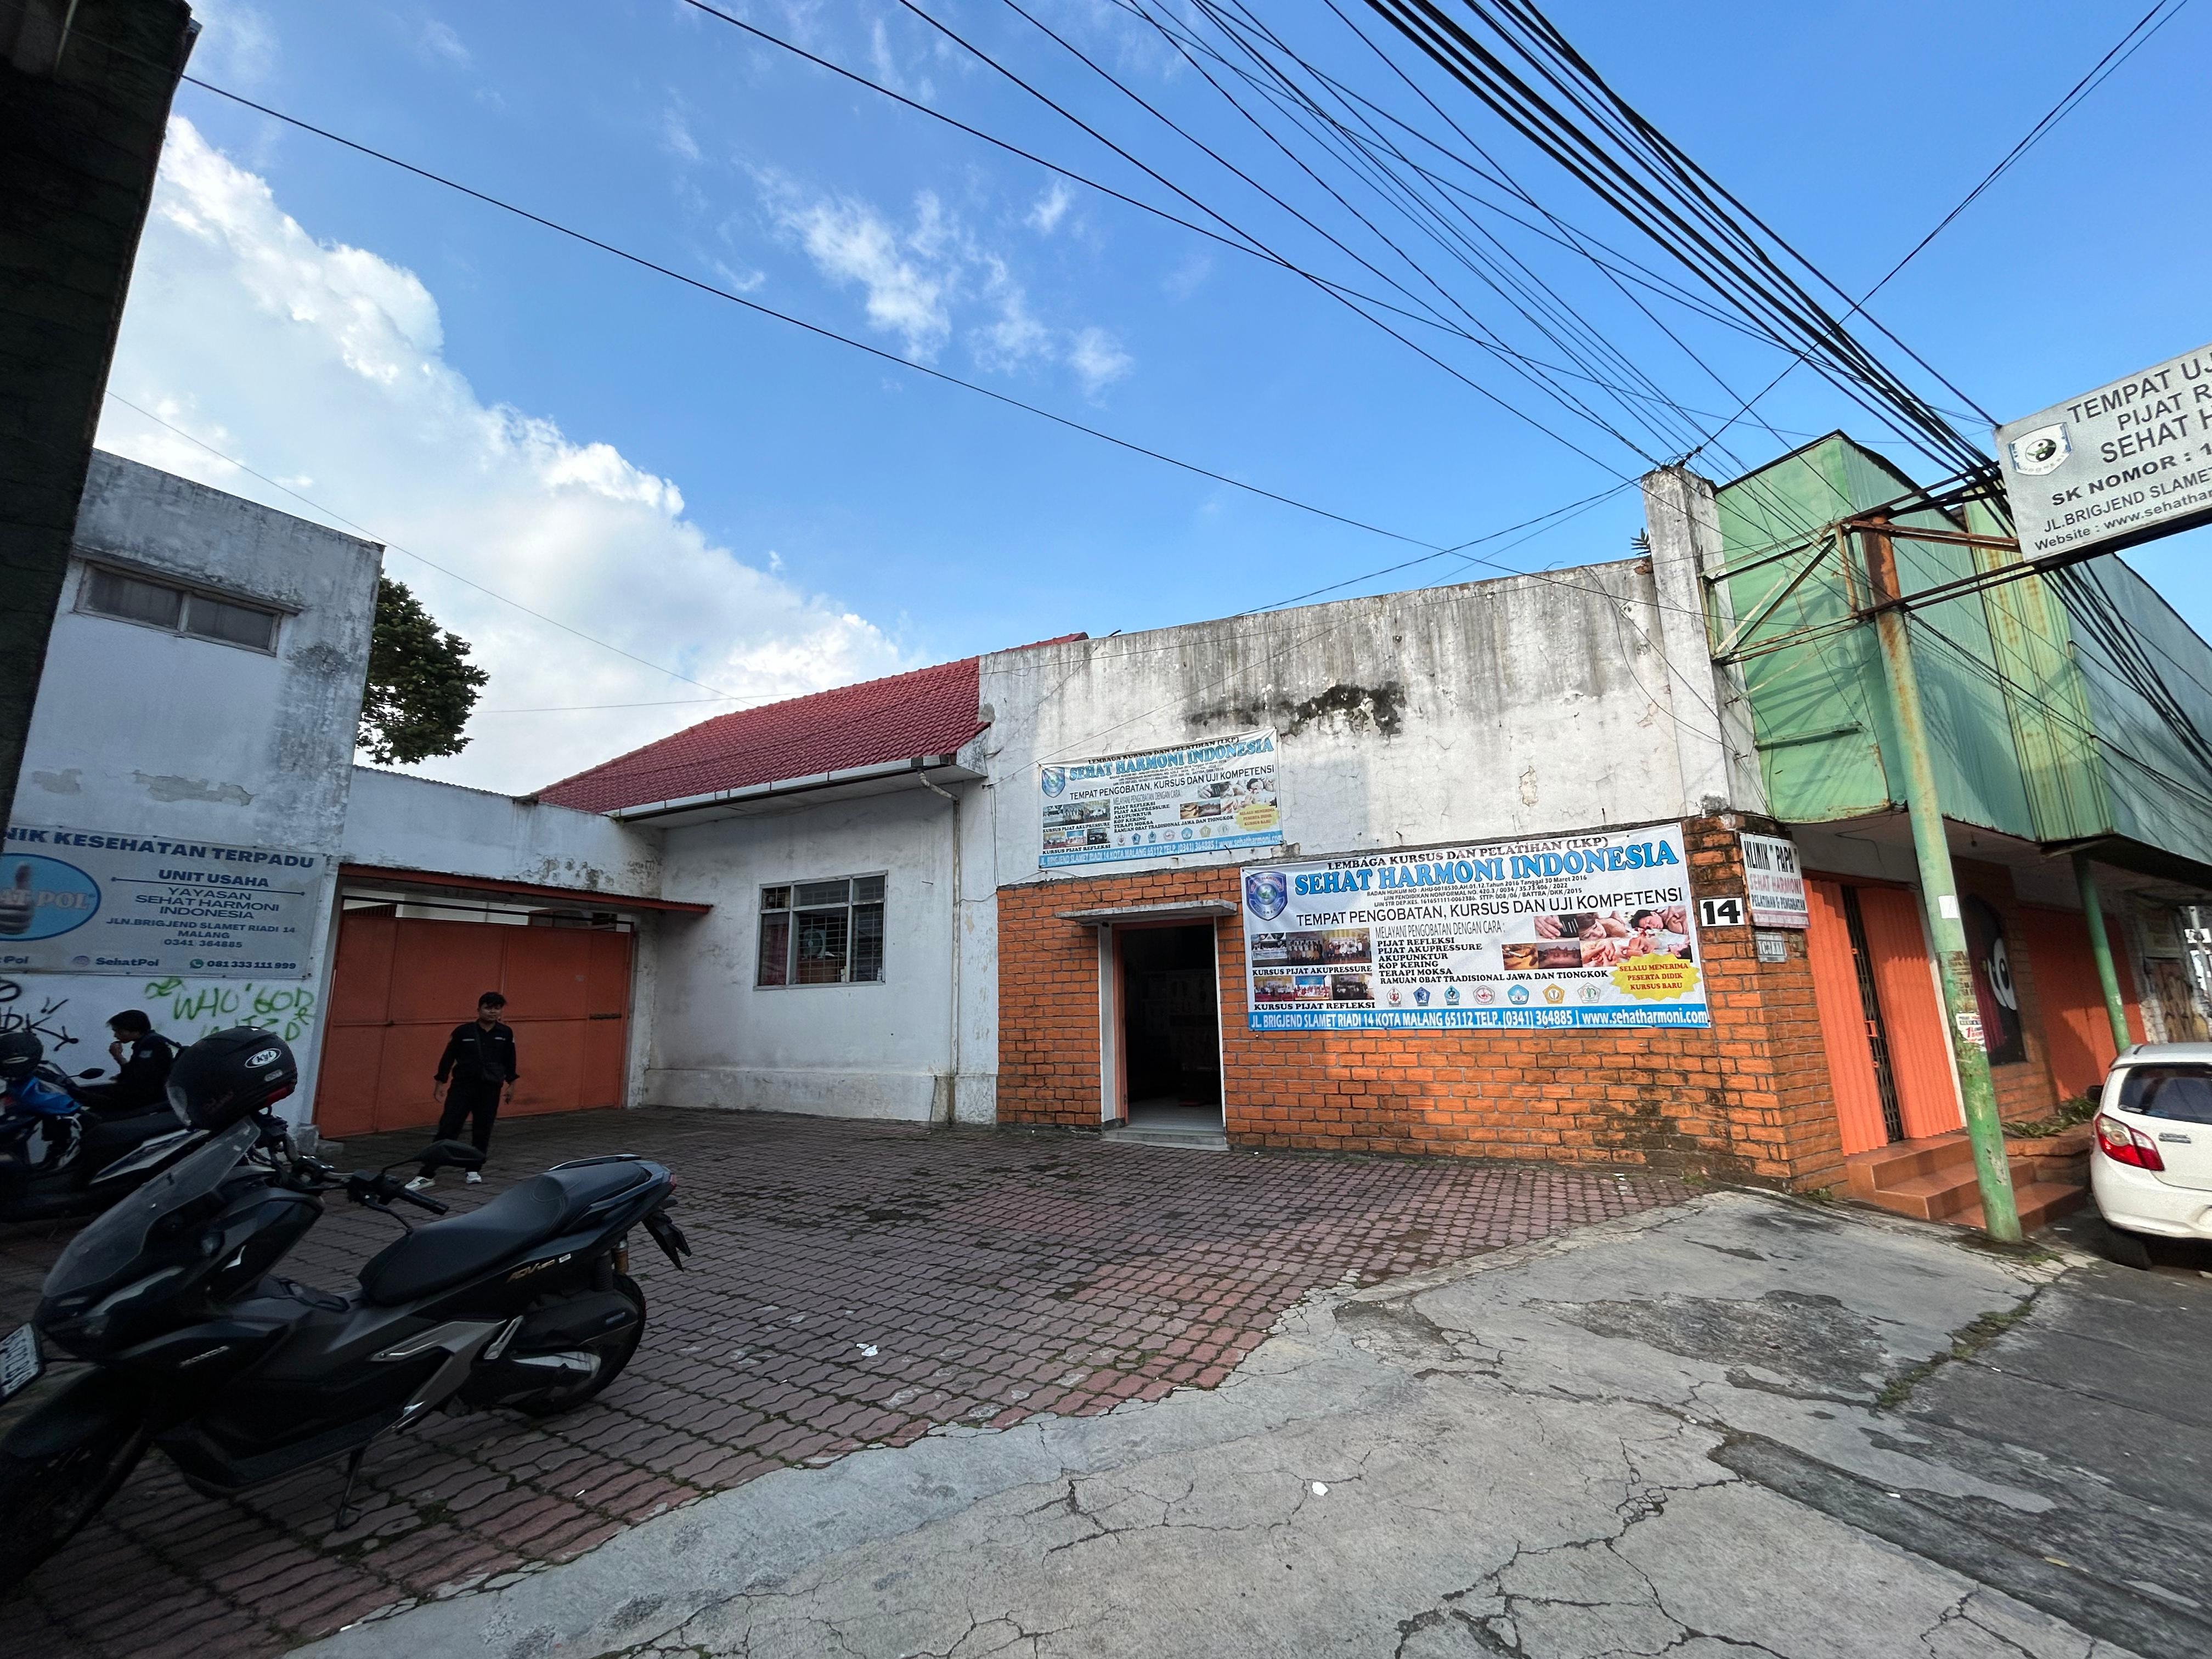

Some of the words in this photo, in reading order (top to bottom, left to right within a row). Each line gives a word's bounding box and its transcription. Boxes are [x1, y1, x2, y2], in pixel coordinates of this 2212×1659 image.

[2067, 369, 2170, 423] TEMPAT
[2117, 392, 2182, 431] PIJAT
[2100, 414, 2188, 462] SEHAT
[2052, 487, 2083, 506] SK
[2089, 455, 2177, 494] NOMOR
[2044, 491, 2146, 533] JL.BRIGJEND
[2151, 467, 2212, 498] SLAME
[2034, 527, 2091, 550] Website
[1070, 763, 1113, 781] SEHAT
[1116, 752, 1185, 775] HARMONI
[1187, 737, 1274, 764] INDONESIA
[1070, 789, 1097, 800] TEMPAT
[1154, 777, 1185, 789] KURSUS
[1187, 775, 1204, 785] DAN
[1206, 772, 1218, 782] UJI
[1221, 764, 1274, 779] KOMPETENSI
[54, 831, 206, 857] KESEHATAN
[212, 848, 314, 868] TERPADU
[1328, 857, 1387, 871] LEMBAGA
[1390, 851, 1443, 865] KURSUS
[1447, 850, 1476, 860] DAN
[1480, 841, 1562, 857] PELATIHAN
[1566, 837, 1609, 850] (LKP)
[1744, 840, 1770, 871] KLINIK
[1295, 868, 1373, 895] SEHAT
[1377, 857, 1505, 889] HARMONI
[1509, 840, 1679, 879] INDONESIA
[159, 870, 205, 882] UNIT
[207, 873, 269, 887] USAHA
[1749, 873, 1769, 891] SEHAT
[1772, 877, 1802, 894] HARMONI
[37, 890, 90, 910] POL
[135, 895, 196, 906] SEHAT
[199, 899, 279, 911] HARMONI
[168, 887, 251, 900] YAYASAN
[160, 906, 255, 919] INDONESIA
[1297, 911, 1346, 926] TEMPAT
[1350, 906, 1447, 923] PENGOBATAN,
[1451, 901, 1509, 917] KURSUS
[1514, 899, 1545, 913] DAN
[1549, 896, 1571, 911] UJI
[1577, 887, 1683, 909] KOMPETENSI
[1703, 900, 1740, 925] 14
[178, 930, 230, 939] MALANG
[200, 922, 245, 931] SLAMET
[1375, 925, 1407, 939] MELAYANI
[1408, 923, 1452, 938] PENGOBATAN
[1453, 921, 1482, 935] DENGAN
[1483, 920, 1502, 933] CARA
[1407, 937, 1455, 945] REFLEKSI
[1408, 943, 1482, 953] AKUPRESSURE
[96, 957, 159, 966] SehatPol
[1379, 953, 1448, 962] AKUPUNKTUR
[1400, 960, 1438, 968] KERING
[1619, 964, 1647, 972] SELALU
[1649, 962, 1689, 971] MENERIMA
[1311, 966, 1372, 974] AKUPRESSURE
[1379, 969, 1415, 977] TERAPI
[1380, 977, 1417, 985] RAMUAN
[1443, 974, 1505, 983] TRADISIONAL
[1506, 972, 1533, 981] JAWA
[1534, 972, 1554, 980] DAN
[1556, 970, 1609, 979] TIONGKOK
[1627, 973, 1660, 981] PESERTA
[1630, 982, 1661, 990] KURSUS
[1251, 1015, 1261, 1029] JL.
[1263, 1014, 1302, 1029] BRIGJEND
[1304, 1014, 1336, 1028] SLAMET
[1338, 1013, 1361, 1027] RIADI
[1363, 1013, 1373, 1026] 14
[1375, 1013, 1402, 1026] KOTA
[1403, 1013, 1443, 1027] MALANG
[1444, 1012, 1473, 1026] 65112
[1476, 1012, 1501, 1025] TELP.
[1503, 1010, 1533, 1028] (0341)
[1536, 1010, 1573, 1025] 364885
[1582, 1007, 1708, 1025] www.sehatharmoni.com
